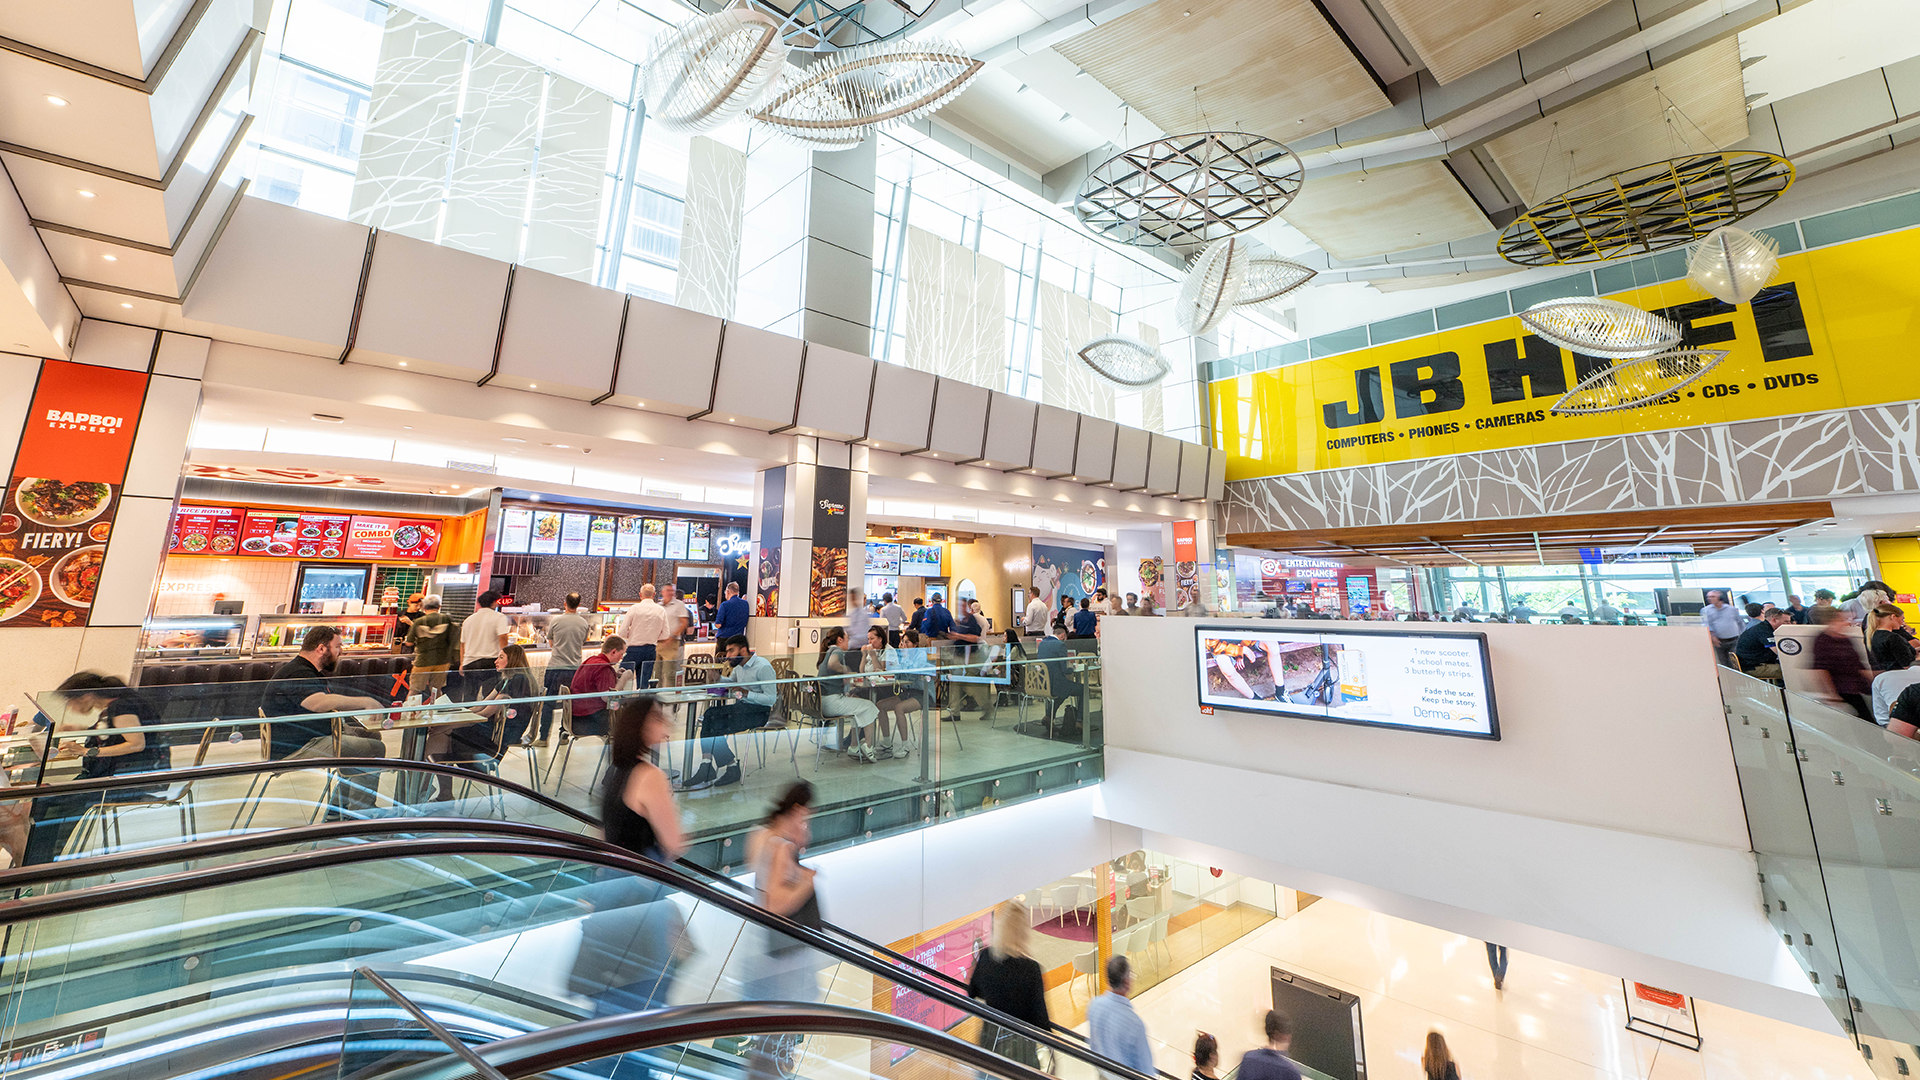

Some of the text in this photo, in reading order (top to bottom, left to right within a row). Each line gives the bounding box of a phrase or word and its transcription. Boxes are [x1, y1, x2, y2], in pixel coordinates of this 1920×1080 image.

[1322, 350, 1465, 430] JB
[1326, 431, 1395, 450] COMPUTERS
[1408, 422, 1460, 439] PHONES
[1475, 409, 1545, 430] CAMERAS
[1702, 382, 1740, 399] CDs
[1763, 372, 1819, 391] DVDs
[46, 409, 123, 428] BAPBOI
[49, 422, 116, 434] EXPRESS
[354, 530, 392, 538] COMBO
[21, 532, 83, 549] FIERY!
[1285, 559, 1344, 568] ENTERTAINMENT
[1296, 569, 1334, 577] EXCHANGE
[821, 577, 837, 588] BITE!
[1417, 658, 1443, 666] school
[1404, 666, 1474, 679] 3 butterfly strips.
[1424, 687, 1442, 695] Fade
[1421, 696, 1477, 708] Keep the story.
[920, 946, 936, 960] THEM
[936, 942, 945, 953] ON
